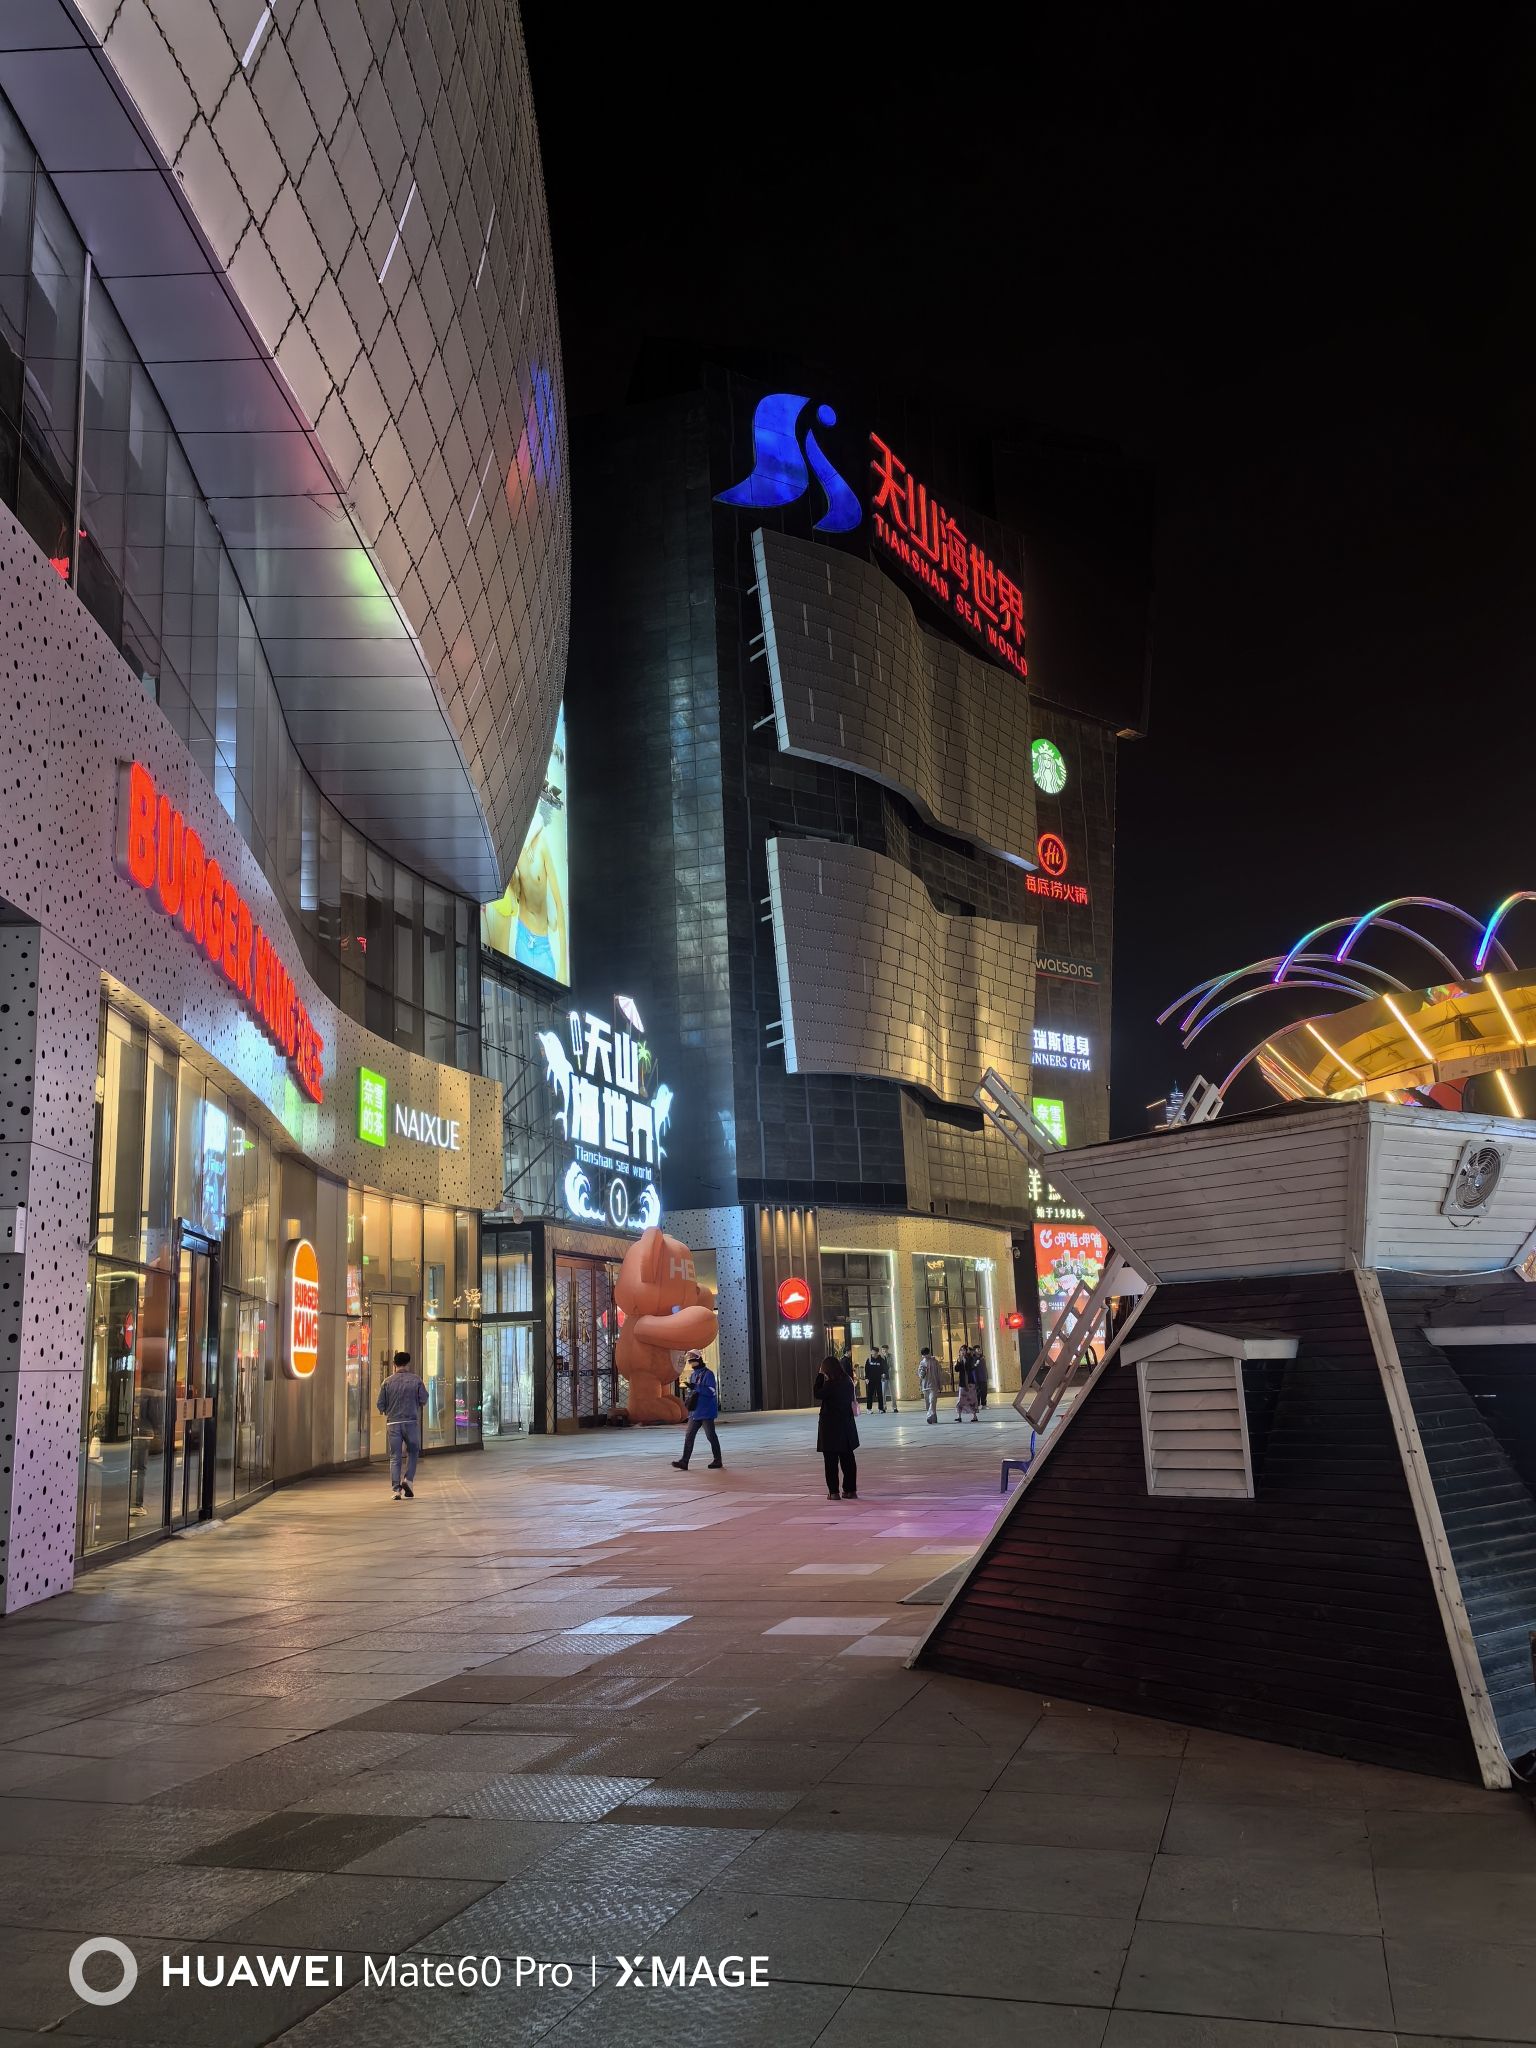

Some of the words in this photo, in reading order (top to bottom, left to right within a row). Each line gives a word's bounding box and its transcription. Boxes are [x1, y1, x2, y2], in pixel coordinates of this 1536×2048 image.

[870, 431, 1026, 645] 天山海世界
[873, 513, 949, 600] TIANSHAN
[955, 593, 982, 632] SEA
[987, 623, 1028, 677] WORLD
[128, 760, 253, 1000] BURGER
[255, 924, 295, 1057] KING
[1035, 957, 1094, 978] watsons
[584, 1011, 640, 1094] 天山
[1070, 1057, 1091, 1071] GYM
[395, 1103, 461, 1151] NAIXUE
[616, 1158, 630, 1174] sea
[632, 1166, 652, 1181] world
[294, 1281, 319, 1310] BURGER
[293, 1312, 319, 1349] KING
[779, 1325, 814, 1339] 必胜客
